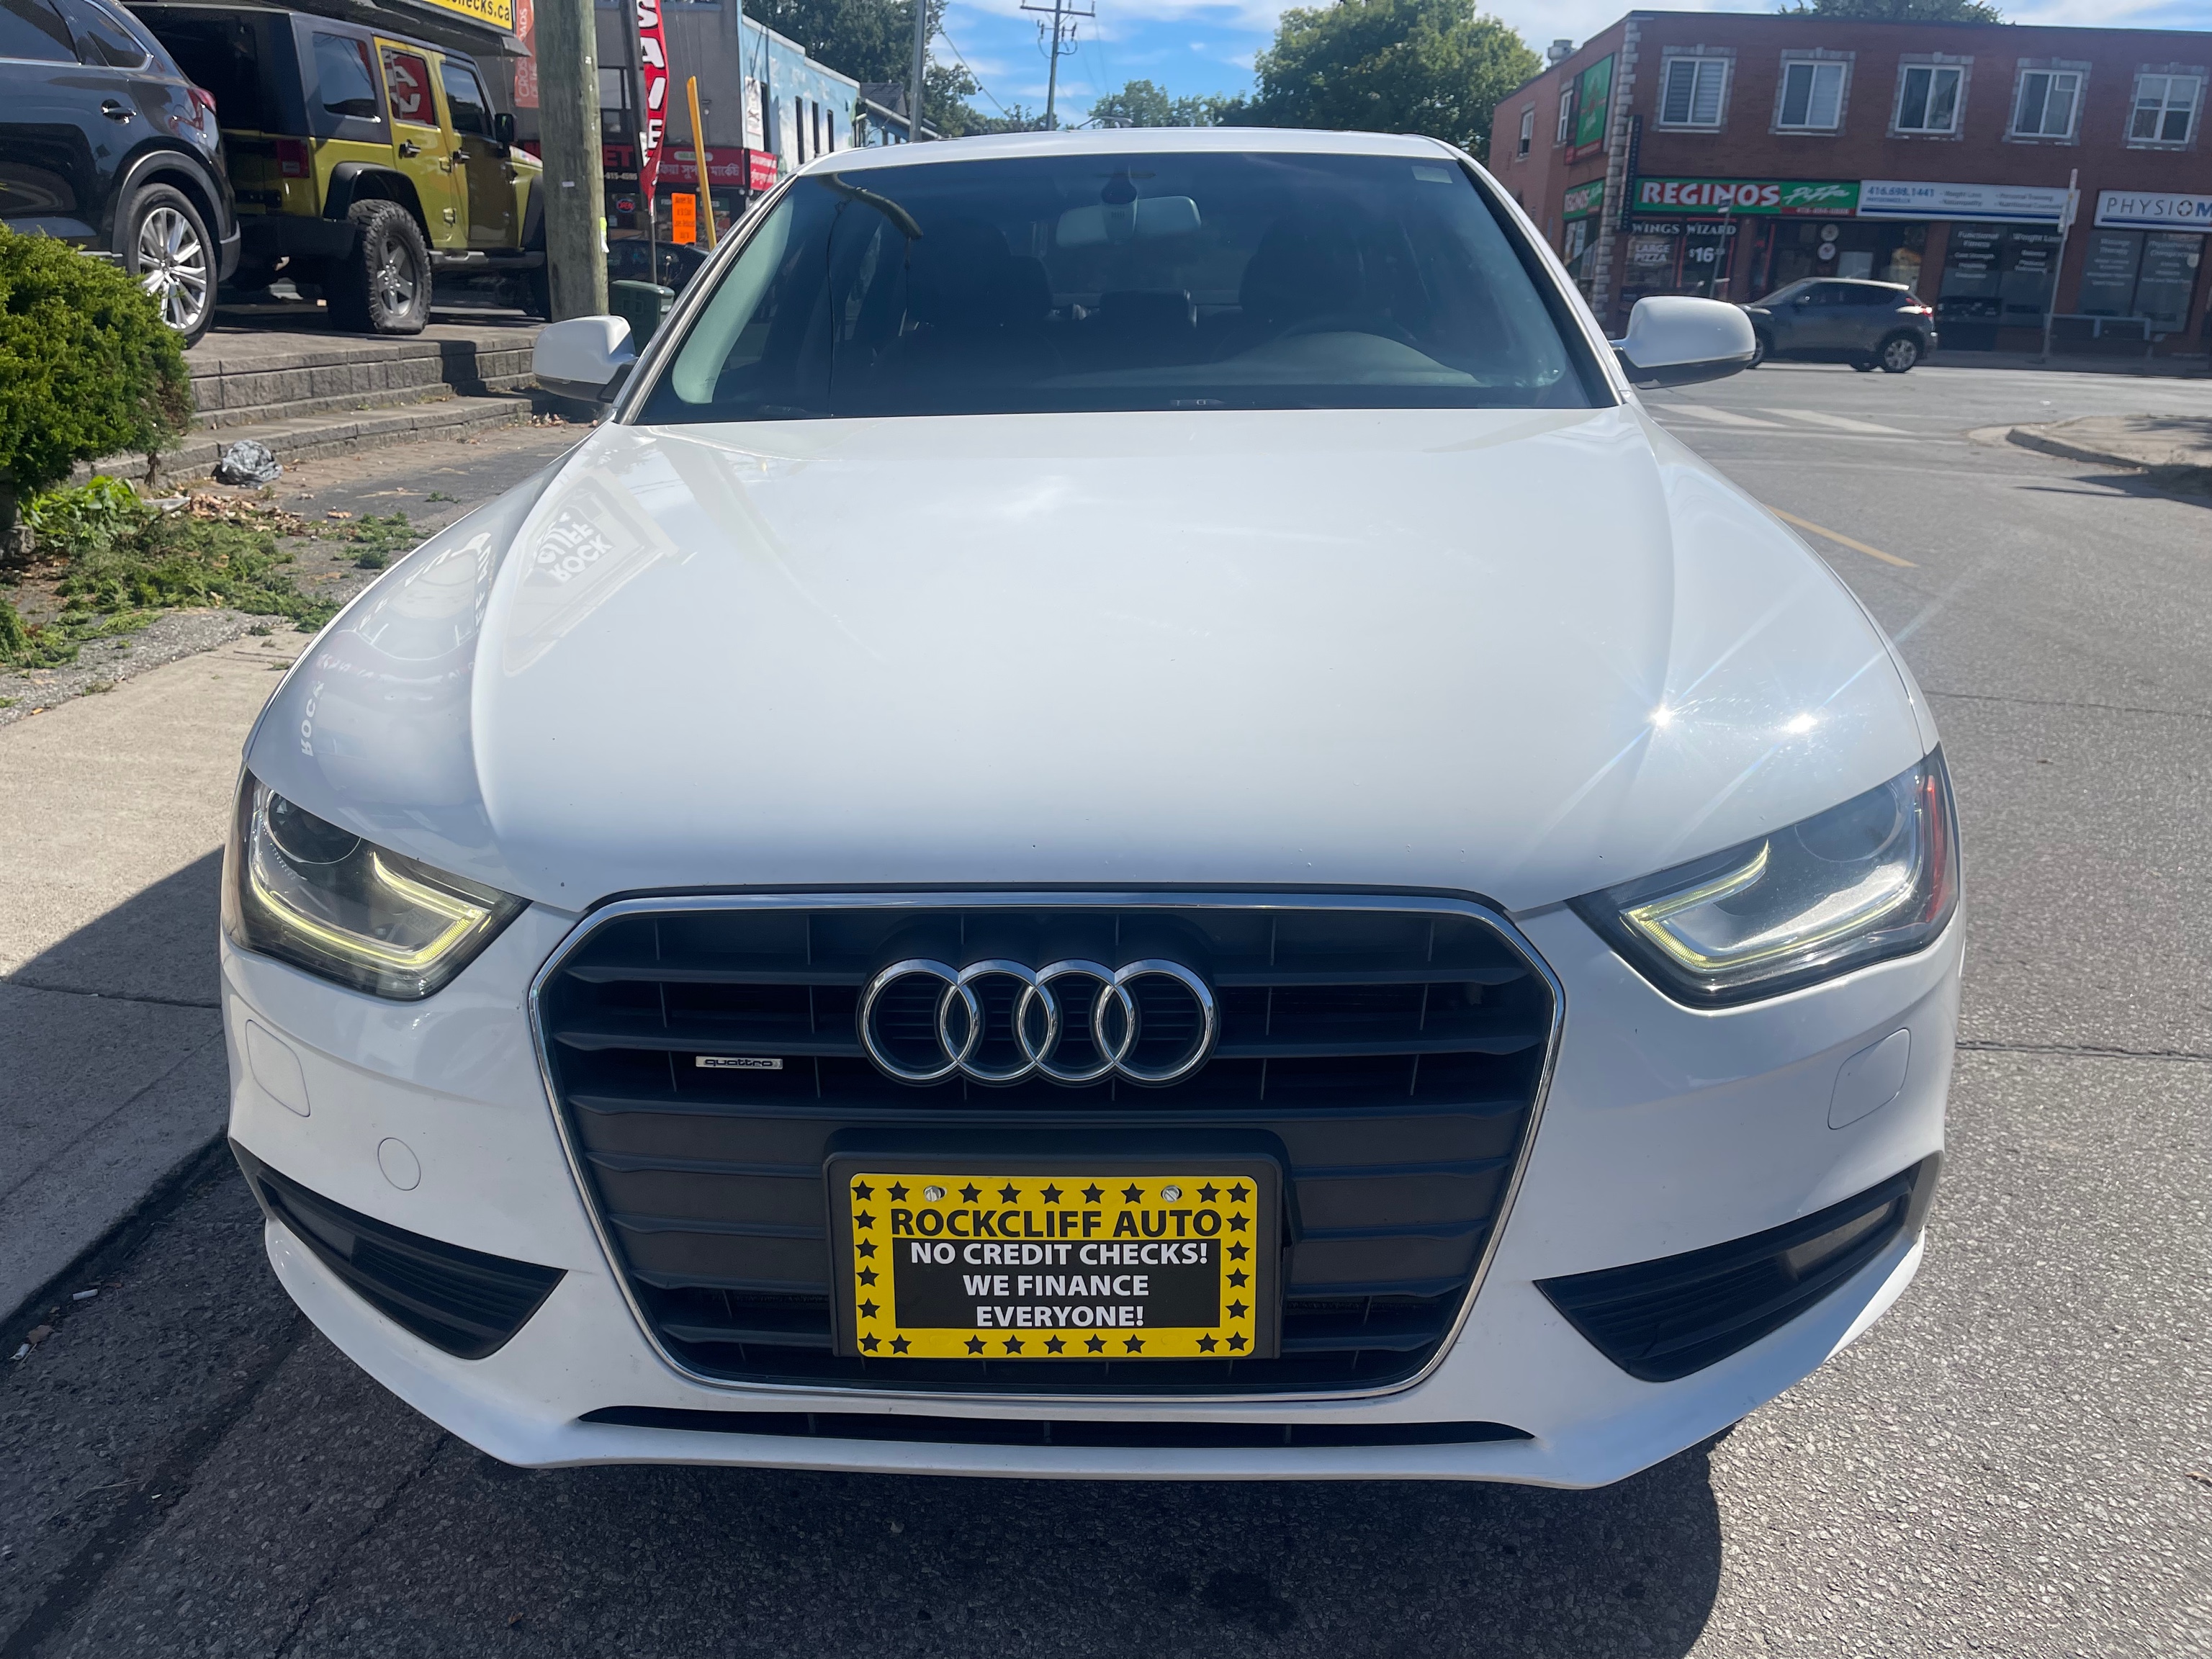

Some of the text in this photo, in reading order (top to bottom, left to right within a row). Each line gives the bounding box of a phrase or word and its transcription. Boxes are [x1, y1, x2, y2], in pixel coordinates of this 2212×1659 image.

[1641, 181, 1780, 207] REGINOS
[1632, 221, 1737, 236] WINGS WIZARD
[704, 1058, 773, 1067] quattro
[891, 1208, 1223, 1238] ROCKCLIFF AUTO
[911, 1242, 1208, 1265] NO CREDIT CHECKS!
[963, 1274, 1149, 1296] WE FINANCE
[976, 1305, 1143, 1327] EVERYONE!
